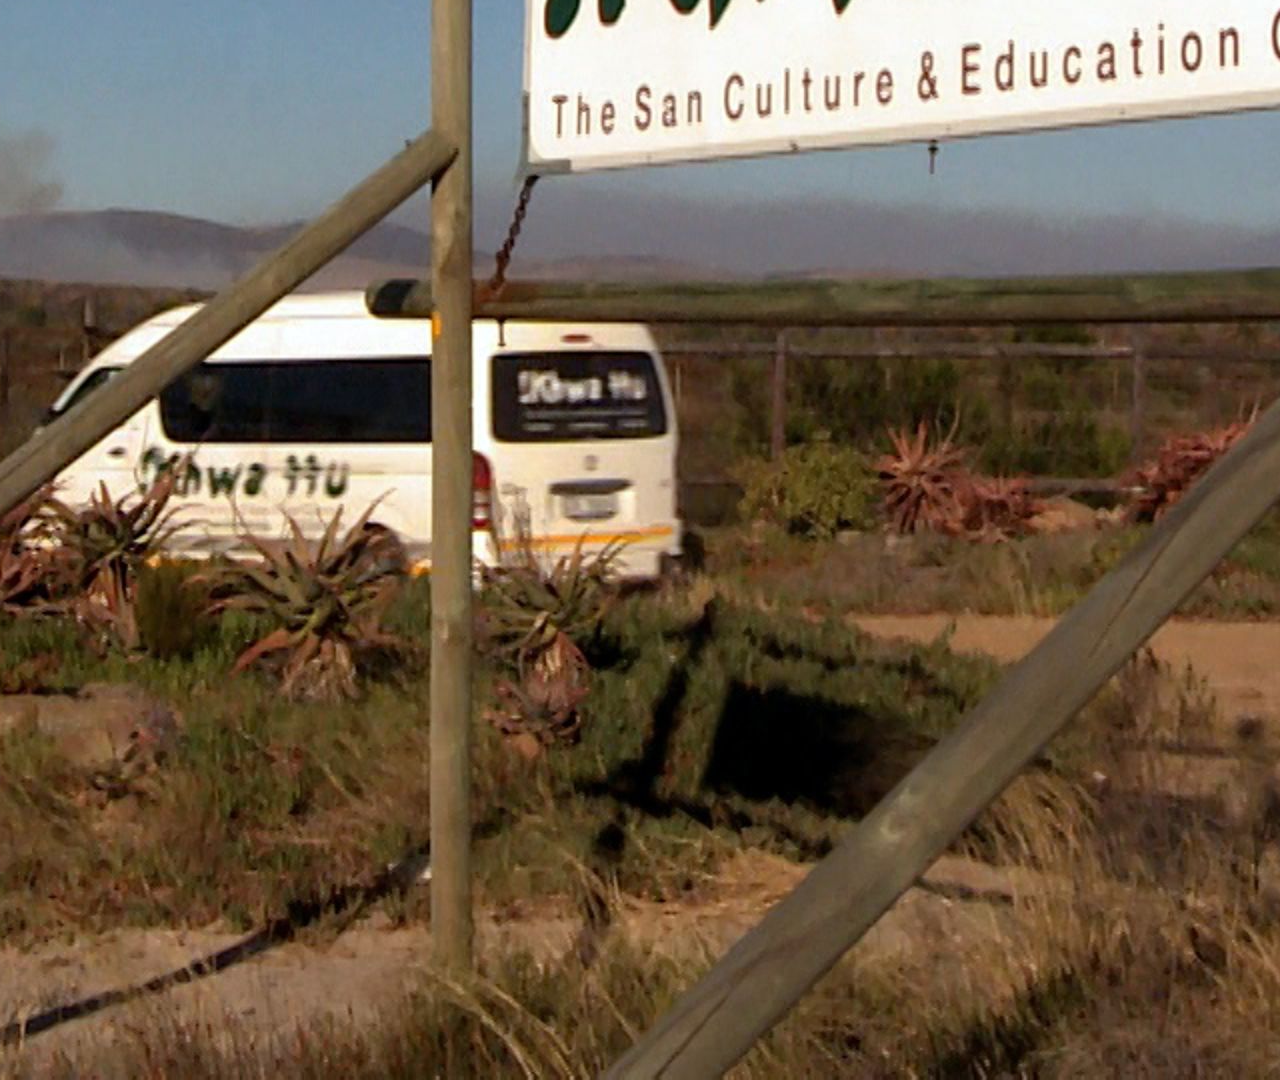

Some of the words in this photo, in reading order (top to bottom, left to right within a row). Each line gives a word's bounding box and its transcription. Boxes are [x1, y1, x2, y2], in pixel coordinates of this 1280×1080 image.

[552, 94, 616, 138] The
[634, 83, 703, 131] San
[723, 67, 894, 121] Culture
[917, 50, 939, 101] &
[961, 25, 1239, 95] Education
